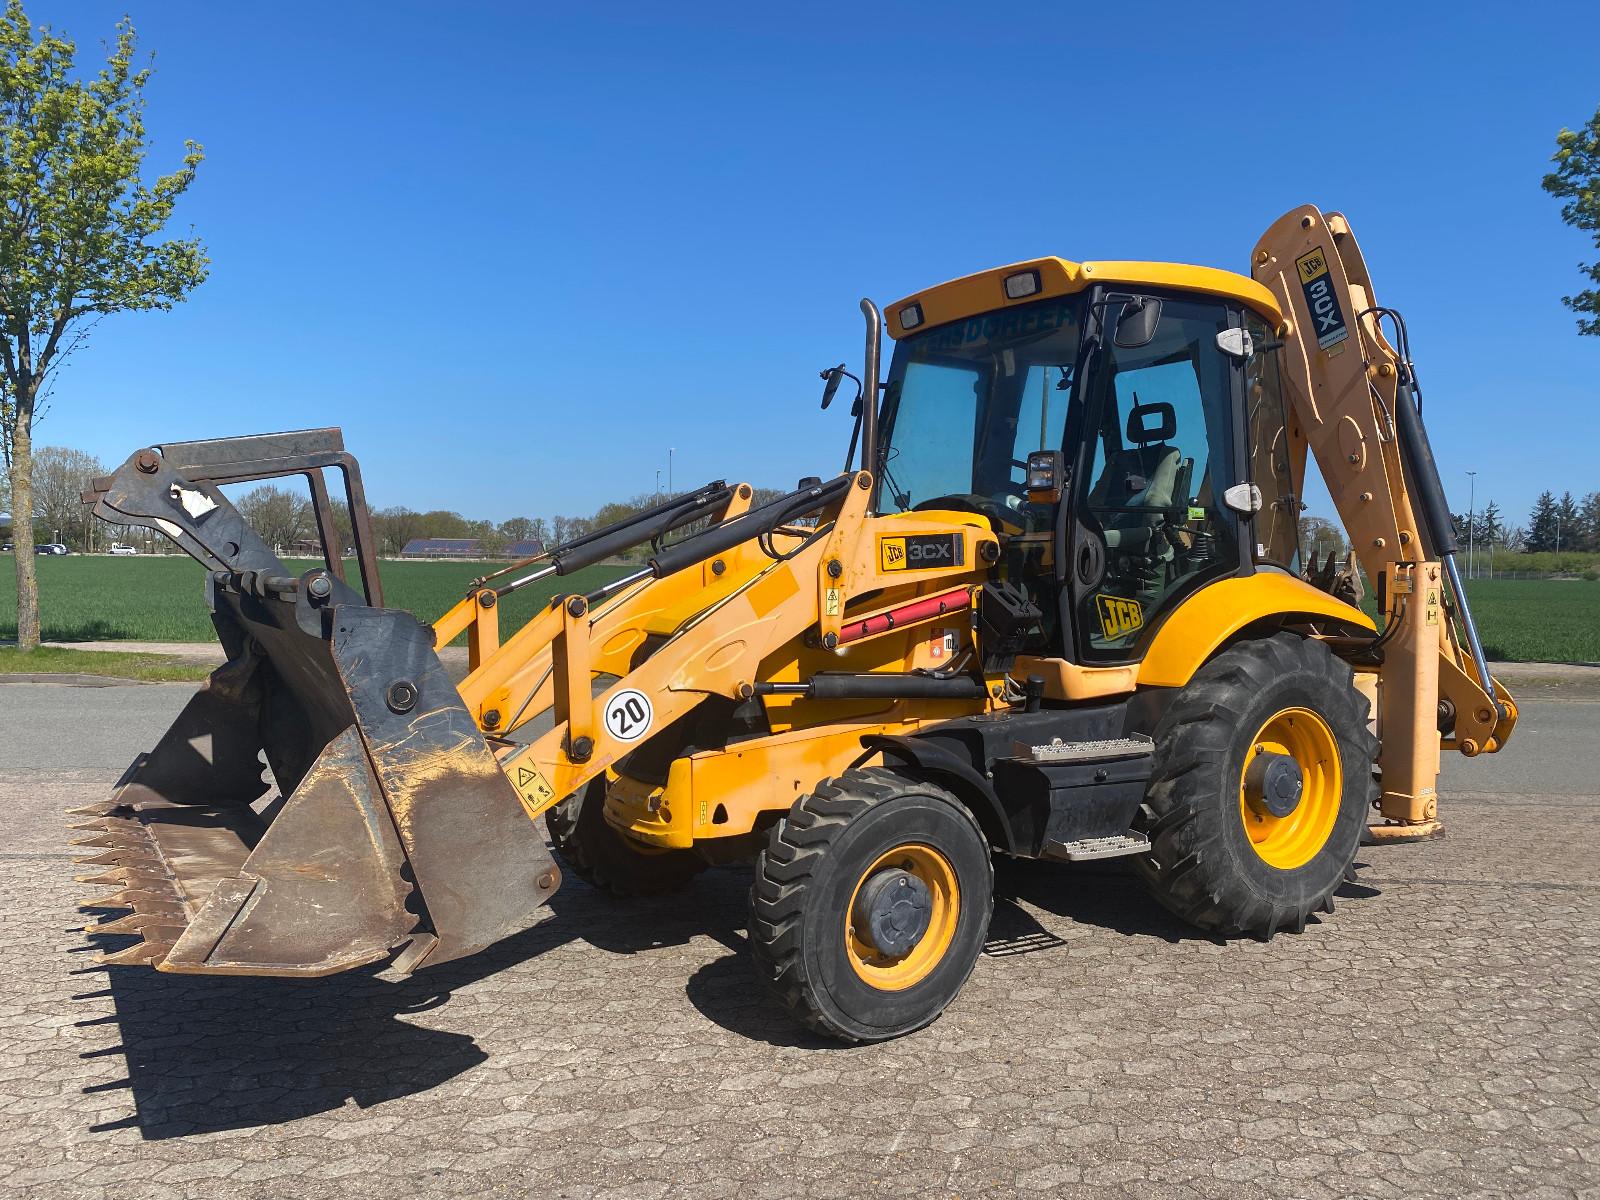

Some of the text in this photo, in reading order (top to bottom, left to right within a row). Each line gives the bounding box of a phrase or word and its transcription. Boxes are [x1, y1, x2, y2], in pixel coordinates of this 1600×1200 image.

[1304, 257, 1322, 275] JCB
[1310, 280, 1340, 332] 3CX
[887, 546, 903, 562] JCB
[909, 543, 951, 560] 3CX
[1104, 599, 1141, 636] JCB
[612, 697, 645, 735] 20
